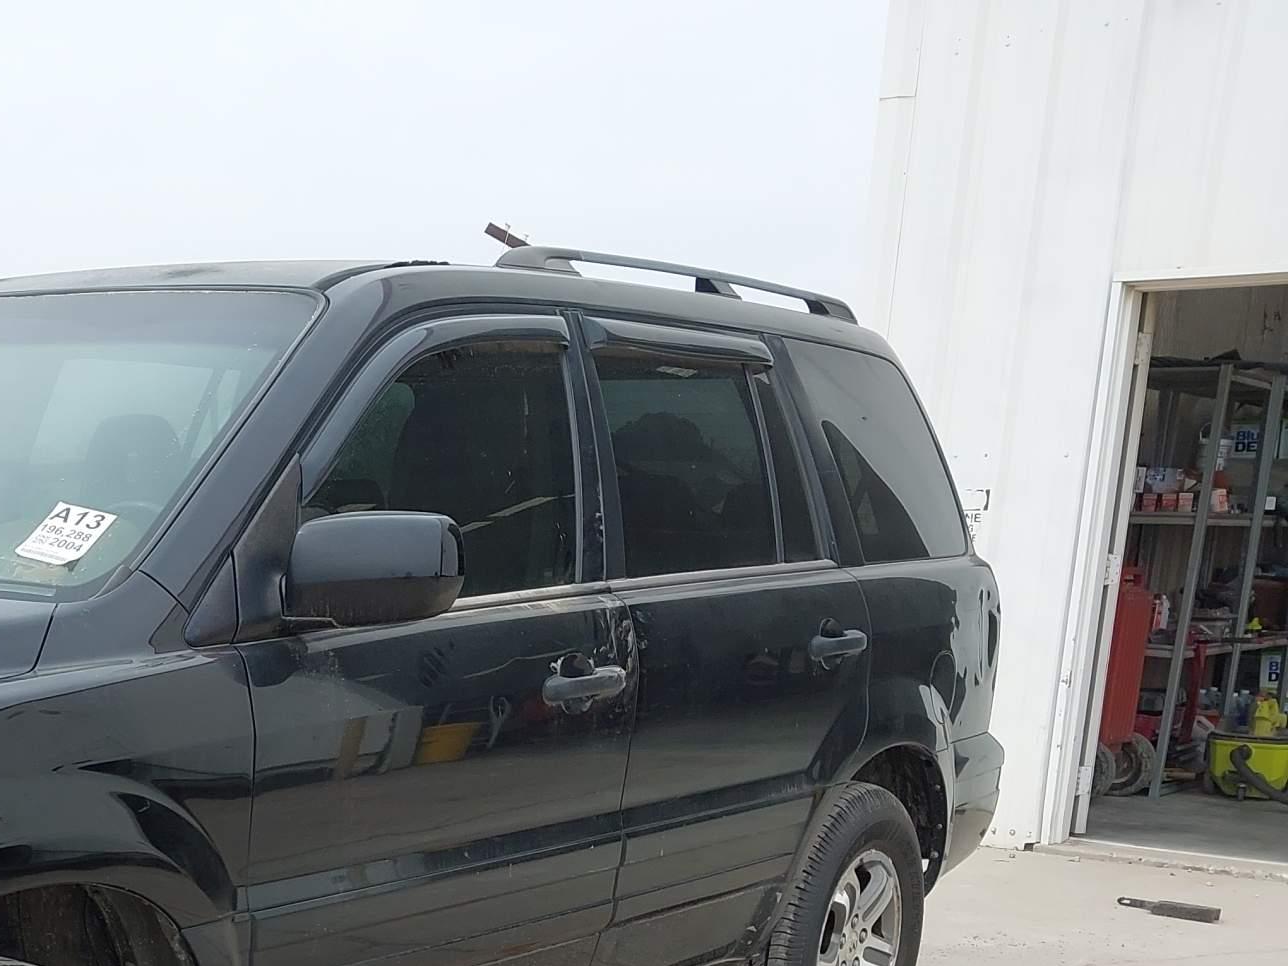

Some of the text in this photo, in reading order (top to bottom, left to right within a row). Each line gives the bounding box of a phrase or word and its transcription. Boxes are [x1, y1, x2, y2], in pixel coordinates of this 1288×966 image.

[1237, 430, 1259, 440] Blu
[1235, 441, 1258, 452] DE
[49, 507, 106, 530] A13
[40, 523, 93, 542] 196,288
[48, 537, 83, 552] 2004
